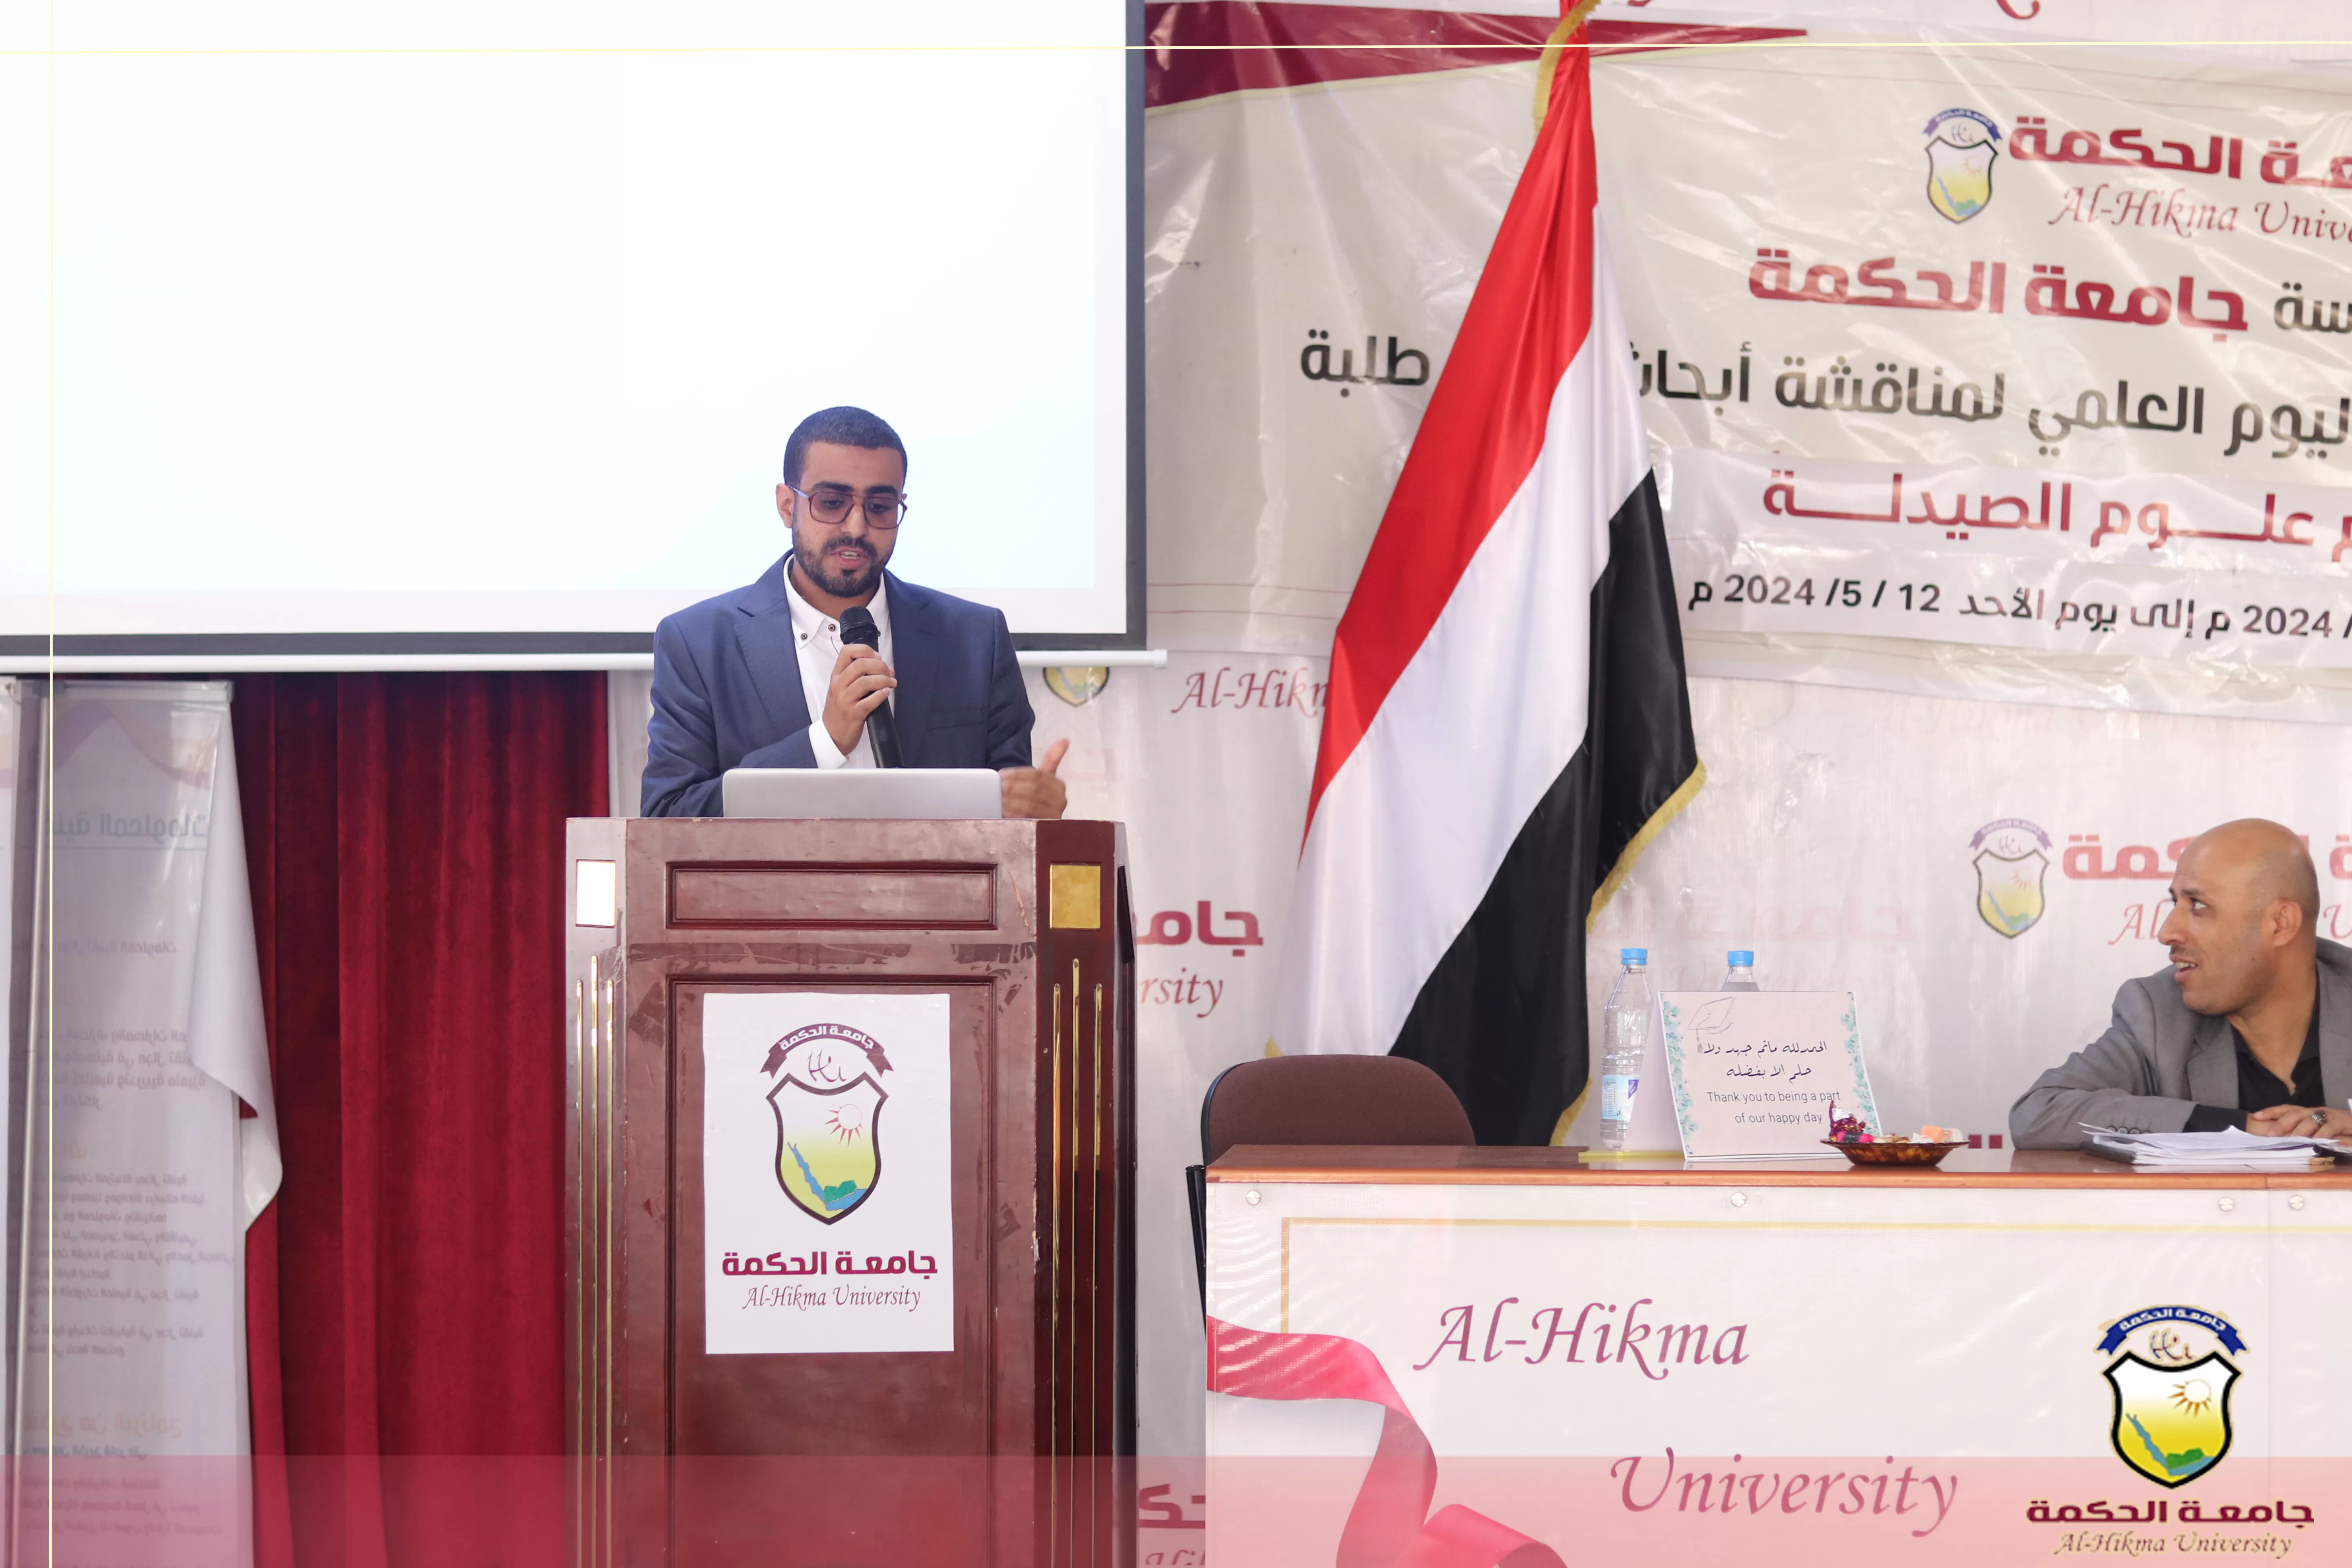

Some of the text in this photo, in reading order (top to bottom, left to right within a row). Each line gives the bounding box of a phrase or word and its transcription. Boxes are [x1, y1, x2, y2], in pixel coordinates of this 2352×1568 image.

[2009, 116, 2241, 179] الحكمة
[2046, 182, 2239, 239] Al-Hikma
[1748, 248, 2006, 314] الحكمة
[2025, 264, 2249, 342] جامعة
[1301, 329, 1430, 396] طلبة
[1775, 357, 2005, 420] لمناقشة
[2028, 380, 2204, 456] العلمي
[1724, 574, 1815, 606] 2024
[1899, 584, 1940, 612] 12
[1960, 588, 2044, 620] الأحد
[2055, 601, 2117, 633] يوم
[2131, 598, 2195, 639] إلى
[2243, 605, 2332, 638] 2024
[779, 1025, 874, 1050] جامعة الحكمة
[1726, 1064, 1766, 1079] بفضله
[1789, 1064, 1811, 1084] حلم
[1706, 1091, 1740, 1102] Thank
[1742, 1093, 1762, 1104] you
[1764, 1092, 1775, 1101] to
[1778, 1091, 1808, 1104] being
[1820, 1091, 1841, 1103] part
[1735, 1112, 1822, 1124] of our happy day
[722, 1250, 937, 1279] جامعة الحكمة
[742, 1284, 921, 1312] Al-Hikma University
[1413, 1298, 1749, 1380] Al-Hikma
[1611, 1447, 1958, 1537] University
